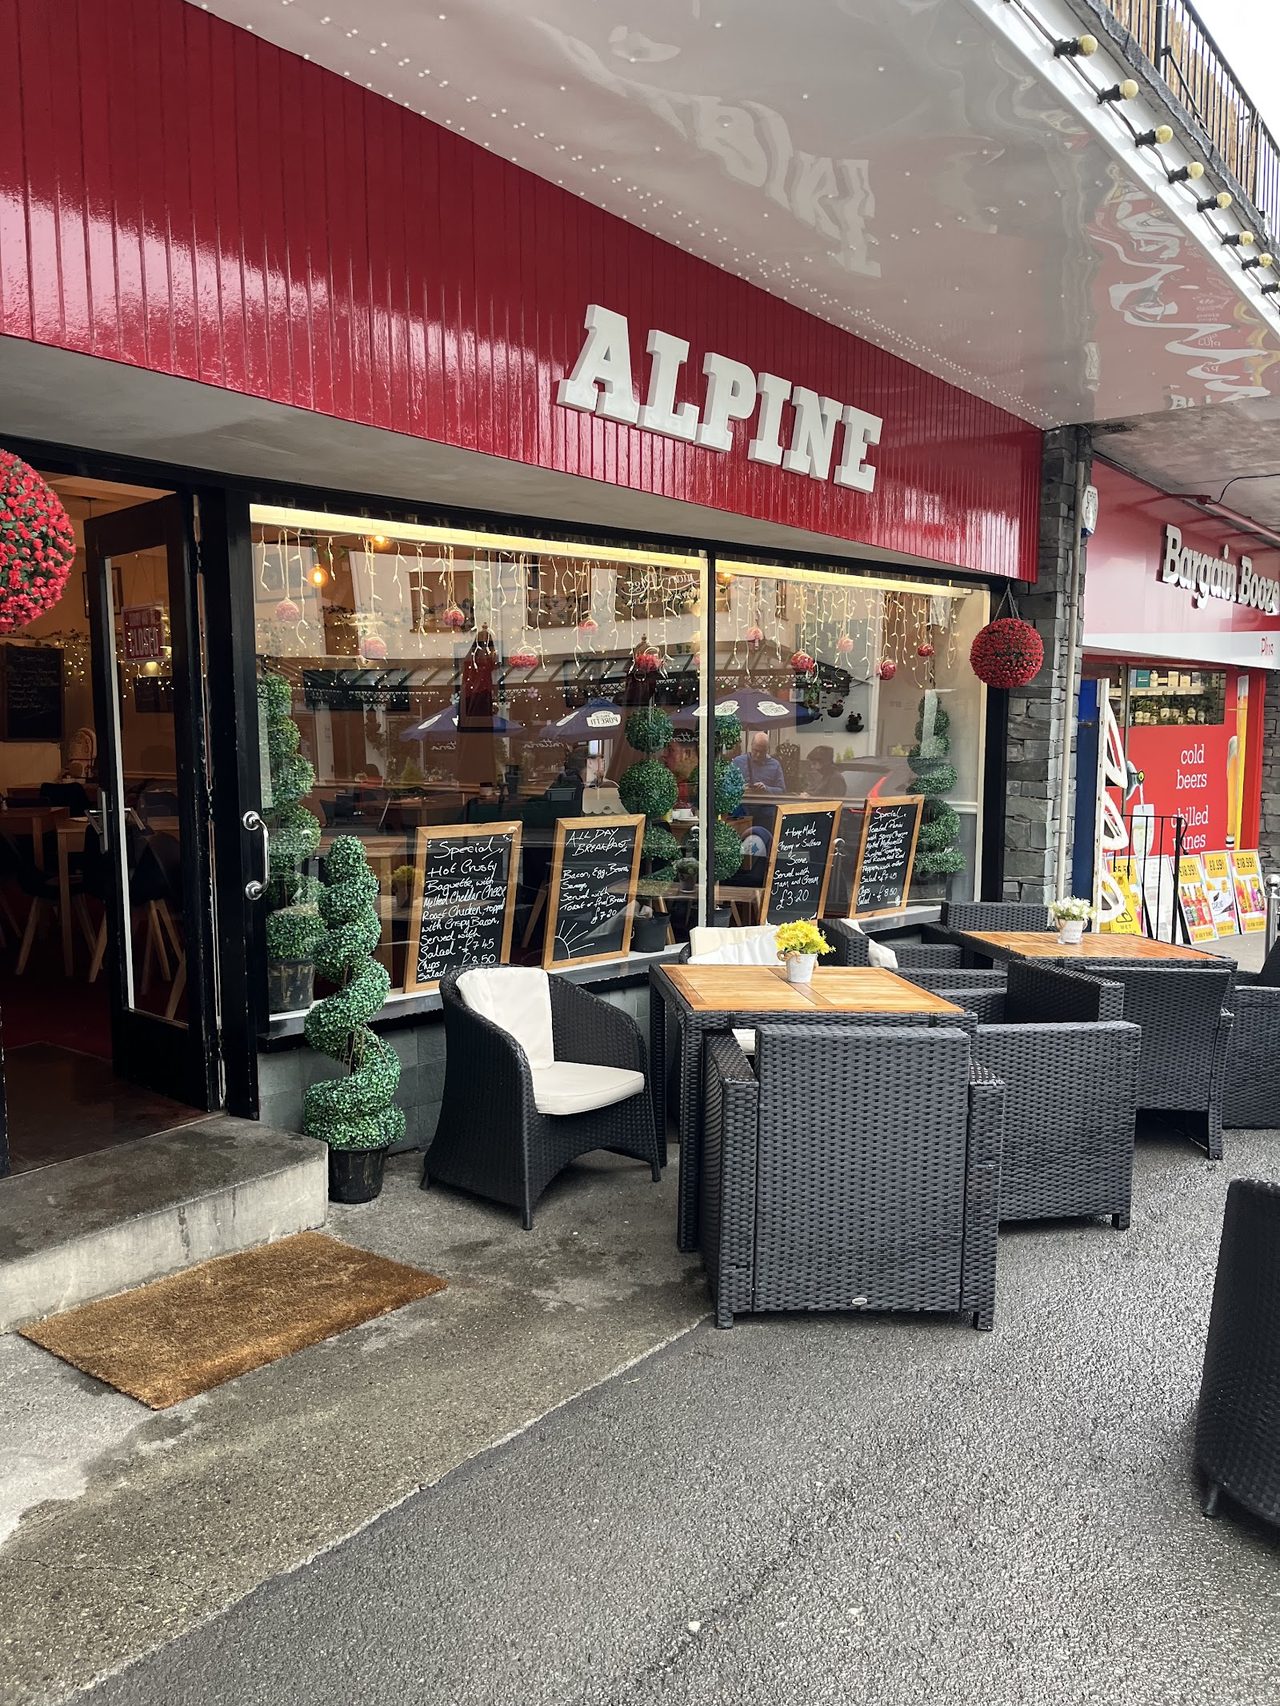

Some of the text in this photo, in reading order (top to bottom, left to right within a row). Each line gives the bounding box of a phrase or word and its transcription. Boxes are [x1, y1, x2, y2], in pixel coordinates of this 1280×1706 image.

[557, 304, 883, 494] ALPINE
[1162, 523, 1237, 609] Bargain
[1180, 743, 1205, 765] cold
[1176, 769, 1208, 790] beers
[566, 828, 619, 847] ALL DAY
[427, 858, 498, 880] Hot Crusty
[773, 867, 795, 880] Served
[476, 876, 494, 886] with
[560, 886, 610, 901] Served with
[422, 908, 448, 921] Roast
[421, 919, 442, 933] with
[445, 918, 470, 933] Crispy
[420, 928, 481, 946] Served with
[418, 941, 456, 961] Salad
[417, 964, 448, 981] Salad
